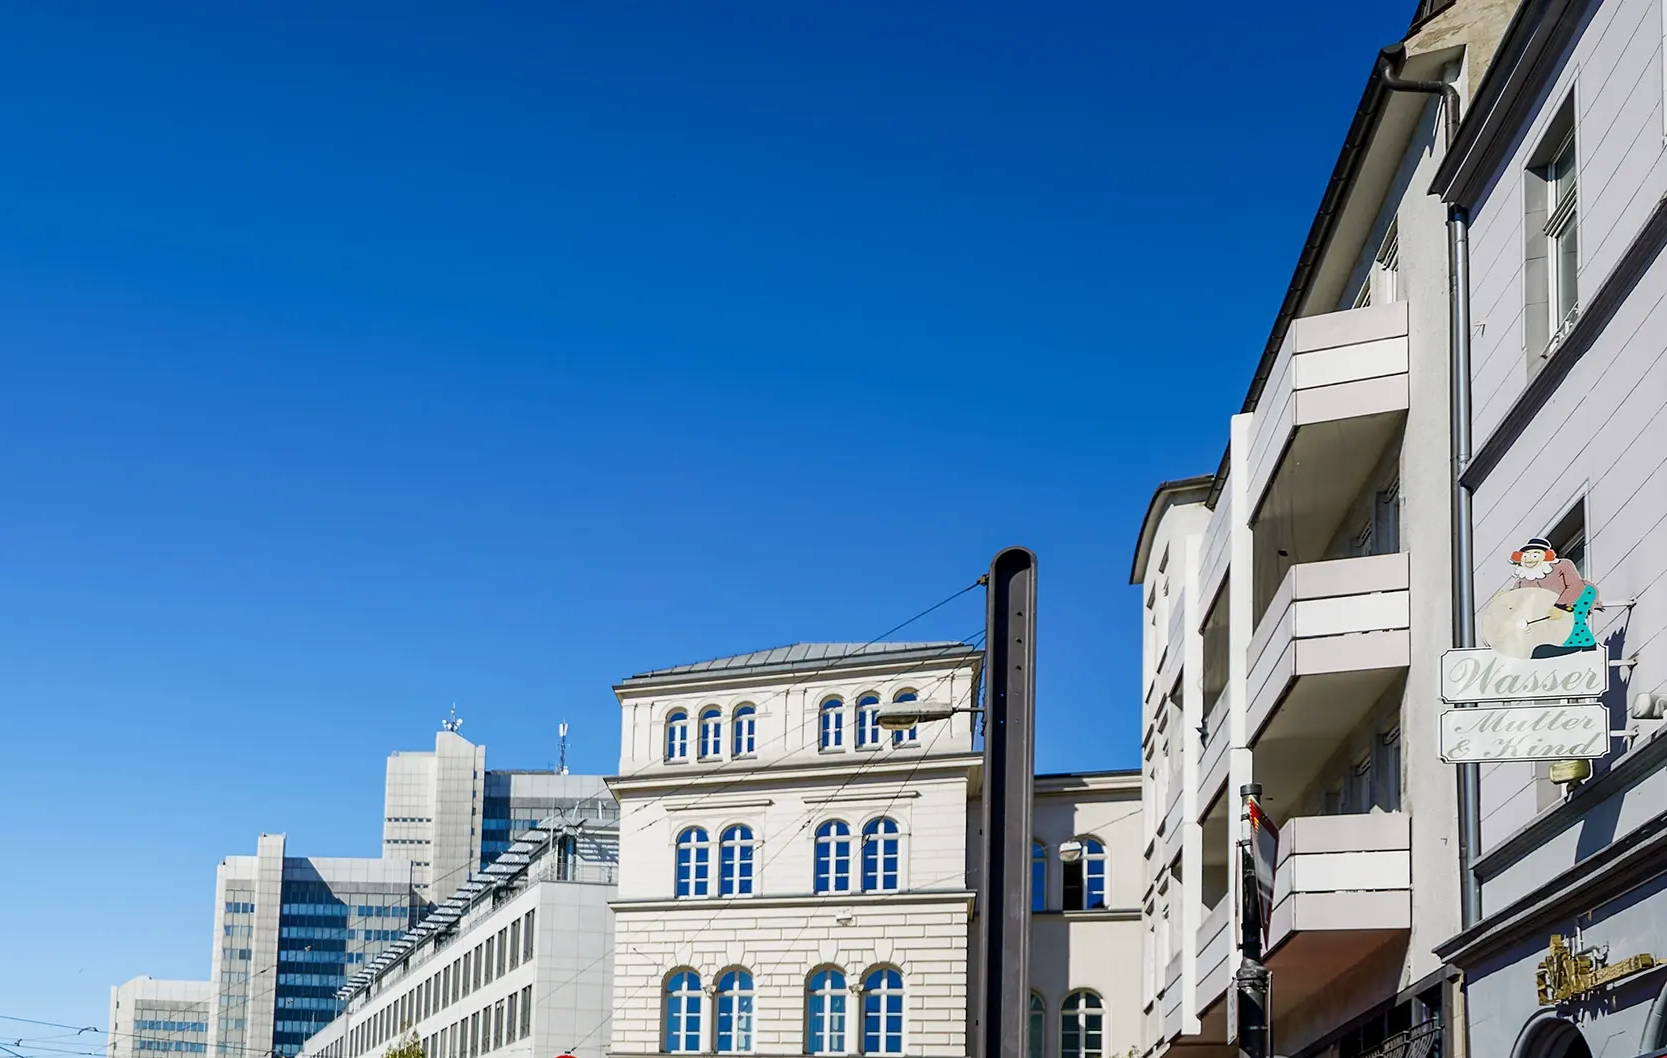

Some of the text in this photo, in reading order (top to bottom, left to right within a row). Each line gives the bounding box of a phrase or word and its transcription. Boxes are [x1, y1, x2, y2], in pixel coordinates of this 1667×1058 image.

[1449, 656, 1600, 696] Wasser
[1454, 709, 1596, 734] Mutter
[1447, 731, 1604, 759] & Kind
